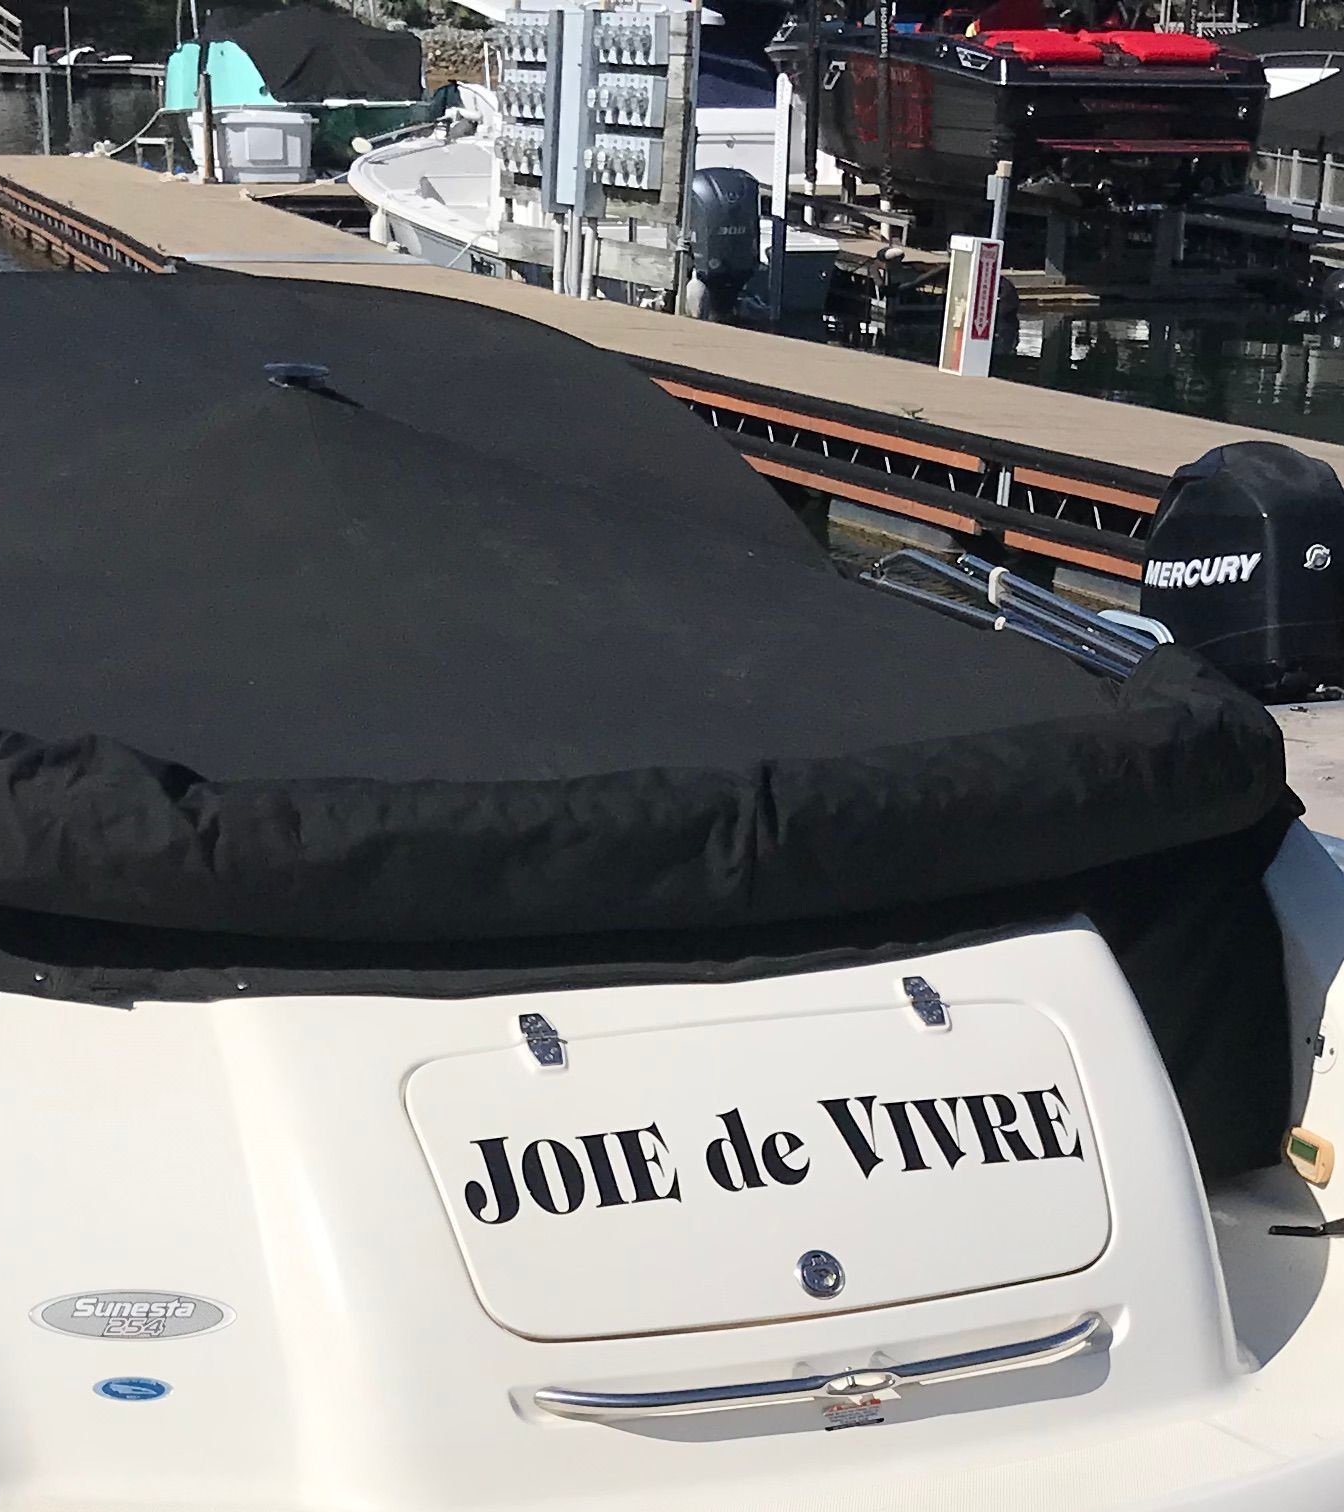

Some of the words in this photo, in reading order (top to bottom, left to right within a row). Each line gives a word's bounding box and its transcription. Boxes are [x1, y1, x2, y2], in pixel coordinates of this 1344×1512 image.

[1144, 552, 1262, 589] MERCURY
[464, 1122, 682, 1225] JOIE
[705, 1107, 810, 1193] de
[816, 1084, 1086, 1179] VIVRE
[72, 1297, 197, 1318] Sunesta
[102, 1317, 167, 1337] 254
